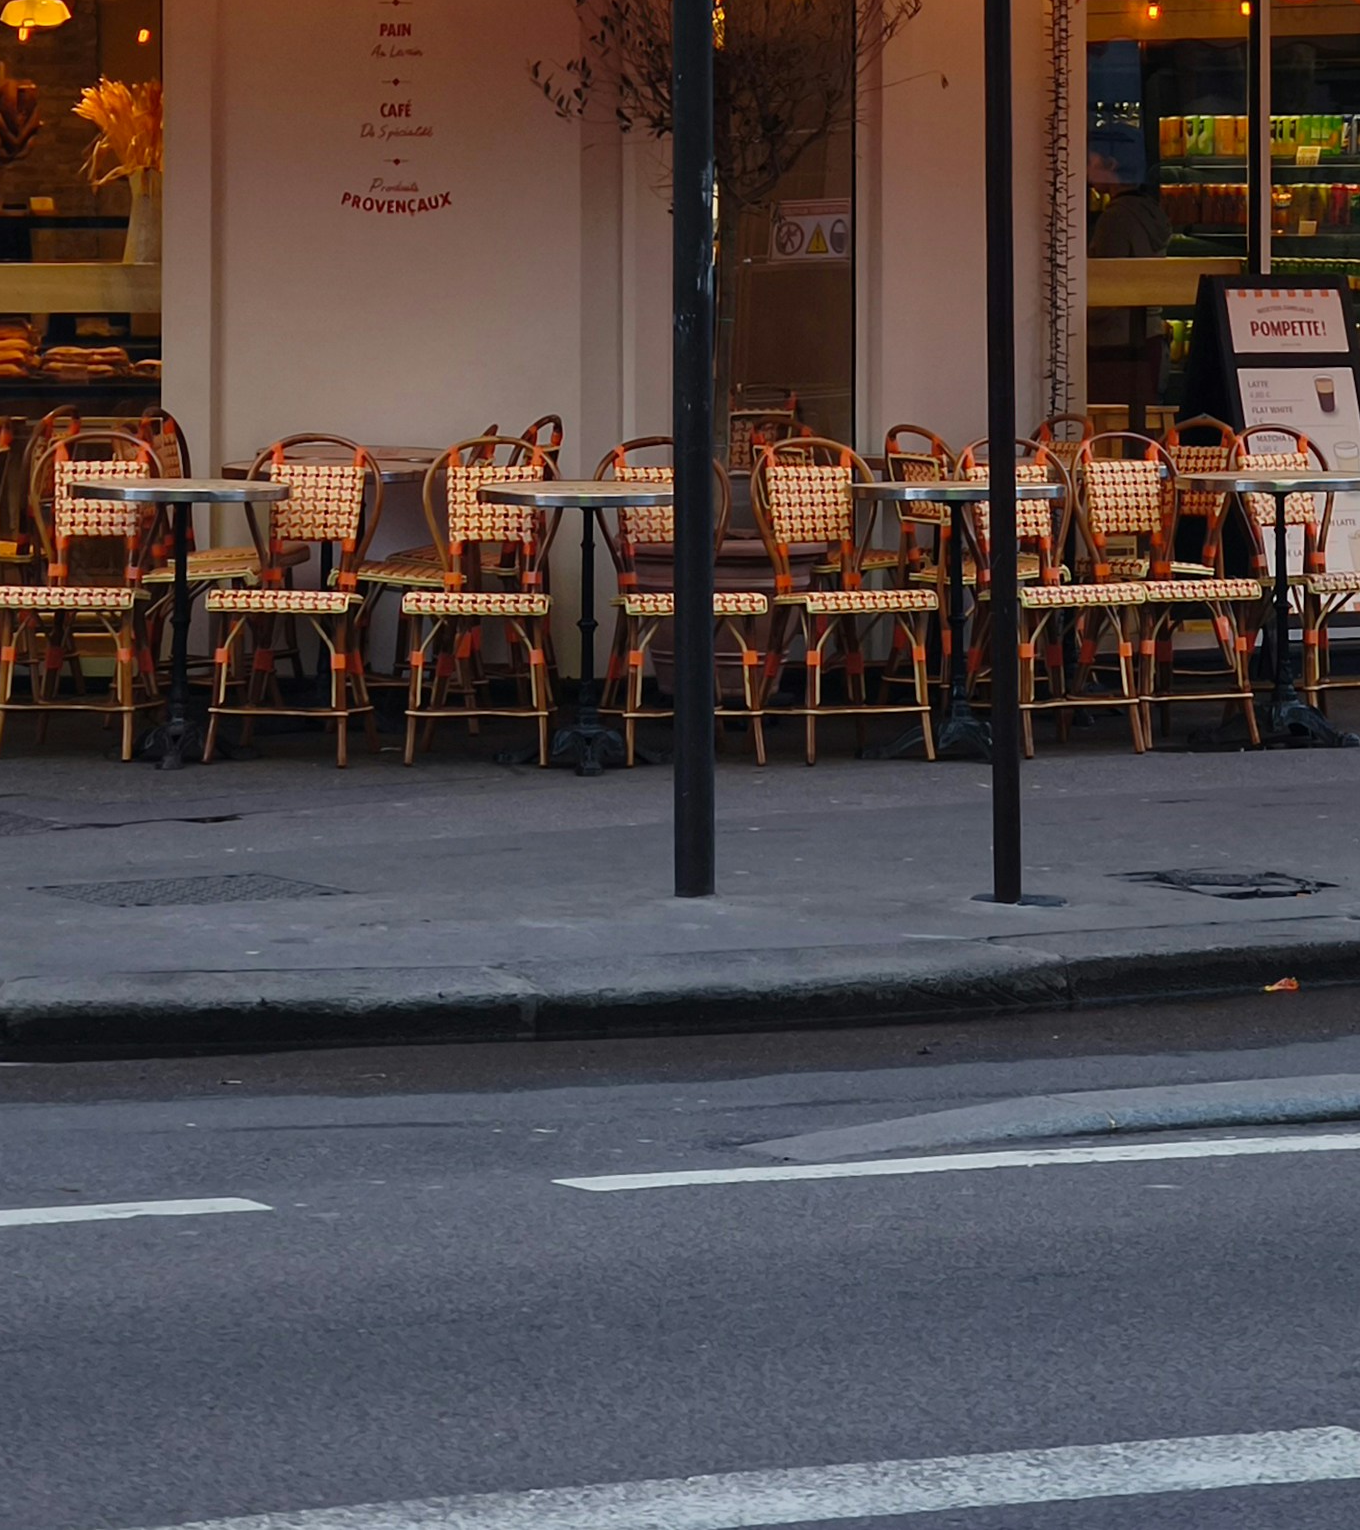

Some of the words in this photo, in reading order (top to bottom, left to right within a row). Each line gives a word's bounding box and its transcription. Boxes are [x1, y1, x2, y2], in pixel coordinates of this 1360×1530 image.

[379, 23, 412, 37] PAIN
[379, 99, 413, 118] CAFÉ
[340, 191, 453, 217] PROVENÇAUX
[1249, 320, 1328, 337] POMPETTE!
[1247, 380, 1269, 388] LATTE
[1251, 406, 1268, 414] FLAT
[1270, 405, 1294, 414] WHITE
[1256, 435, 1287, 443] MATCHA
